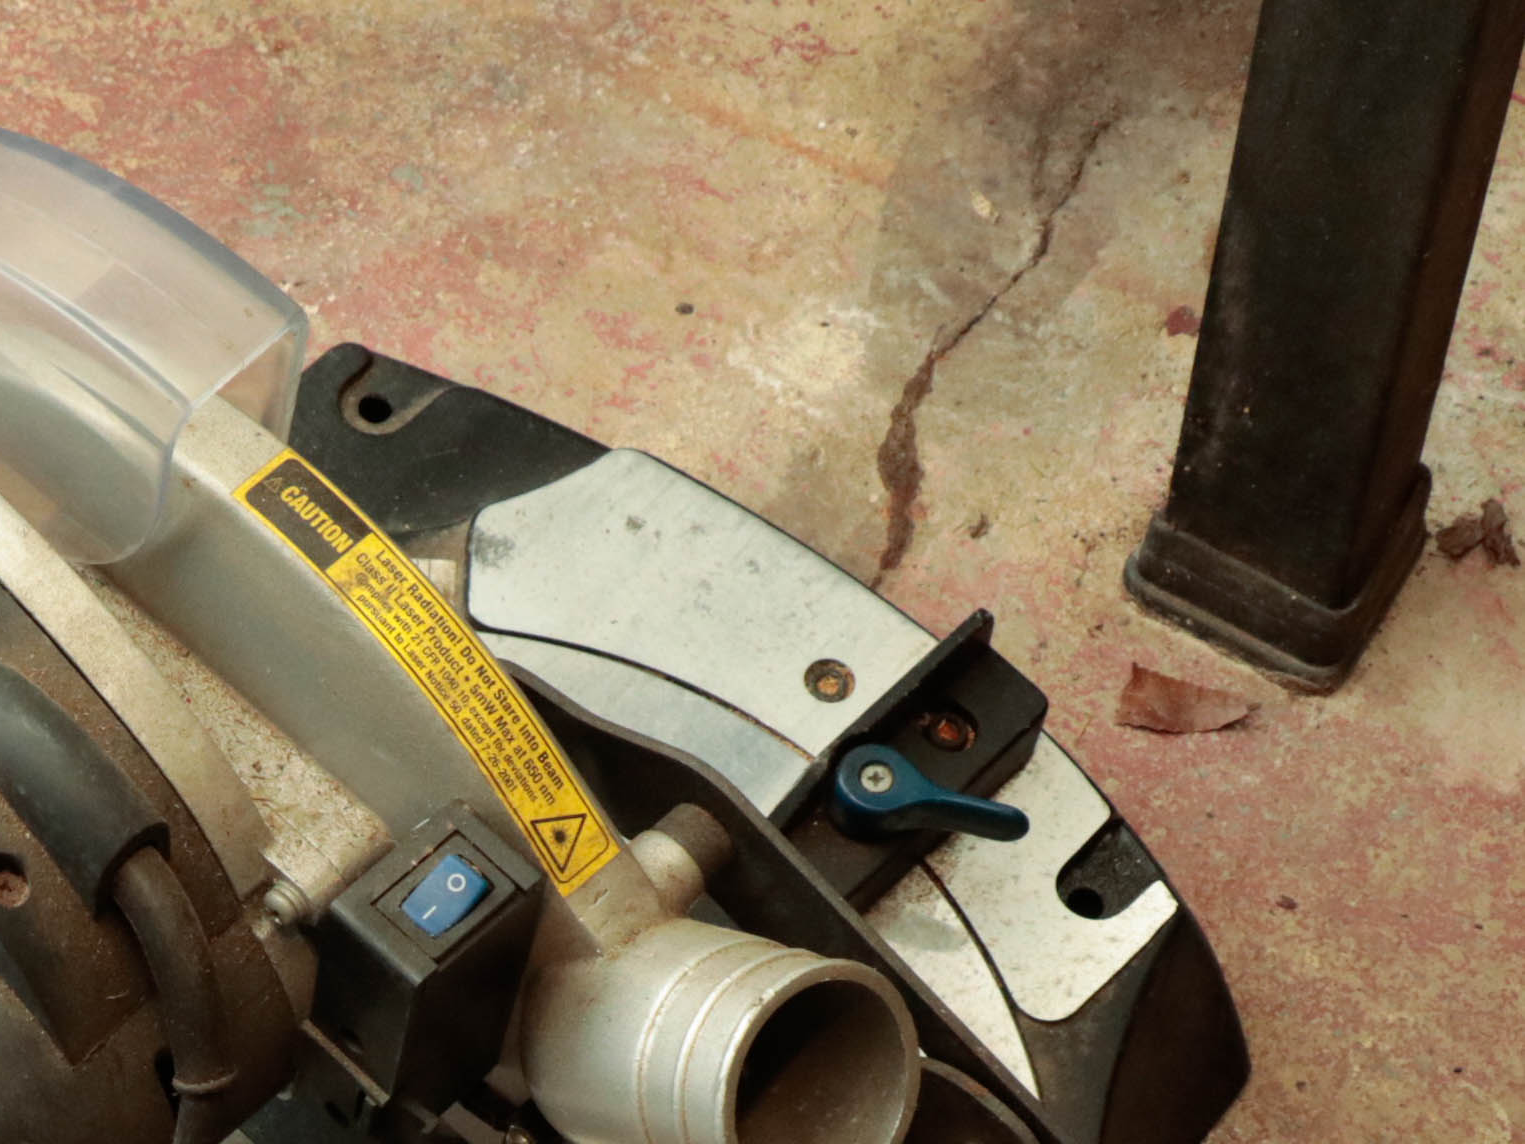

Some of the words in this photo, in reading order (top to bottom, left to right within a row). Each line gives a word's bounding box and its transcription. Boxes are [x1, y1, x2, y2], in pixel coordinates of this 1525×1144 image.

[277, 483, 354, 555] CAUTION
[354, 551, 389, 586] Class
[393, 592, 427, 628] Laser
[422, 625, 465, 675] Product
[468, 682, 498, 716] 5mW
[493, 715, 517, 744] Max
[512, 743, 528, 759] at
[521, 757, 545, 785] 650
[538, 783, 556, 806] nm
[355, 593, 397, 634] pursuant
[393, 632, 406, 644] to
[402, 642, 427, 670] Laser
[423, 669, 451, 701] Notice
[459, 716, 485, 744] dated
[374, 549, 410, 585] Laser
[405, 582, 464, 647] Radiation!
[459, 645, 479, 666] Do
[473, 664, 497, 690] Not
[492, 688, 523, 725] Stare
[517, 723, 542, 752] Into
[536, 751, 567, 791] Beam
[392, 611, 413, 633] with
[409, 632, 423, 647] 21
[420, 645, 439, 666] CFR
[466, 705, 496, 739] except
[491, 737, 506, 753] for
[502, 752, 539, 802] deviations
